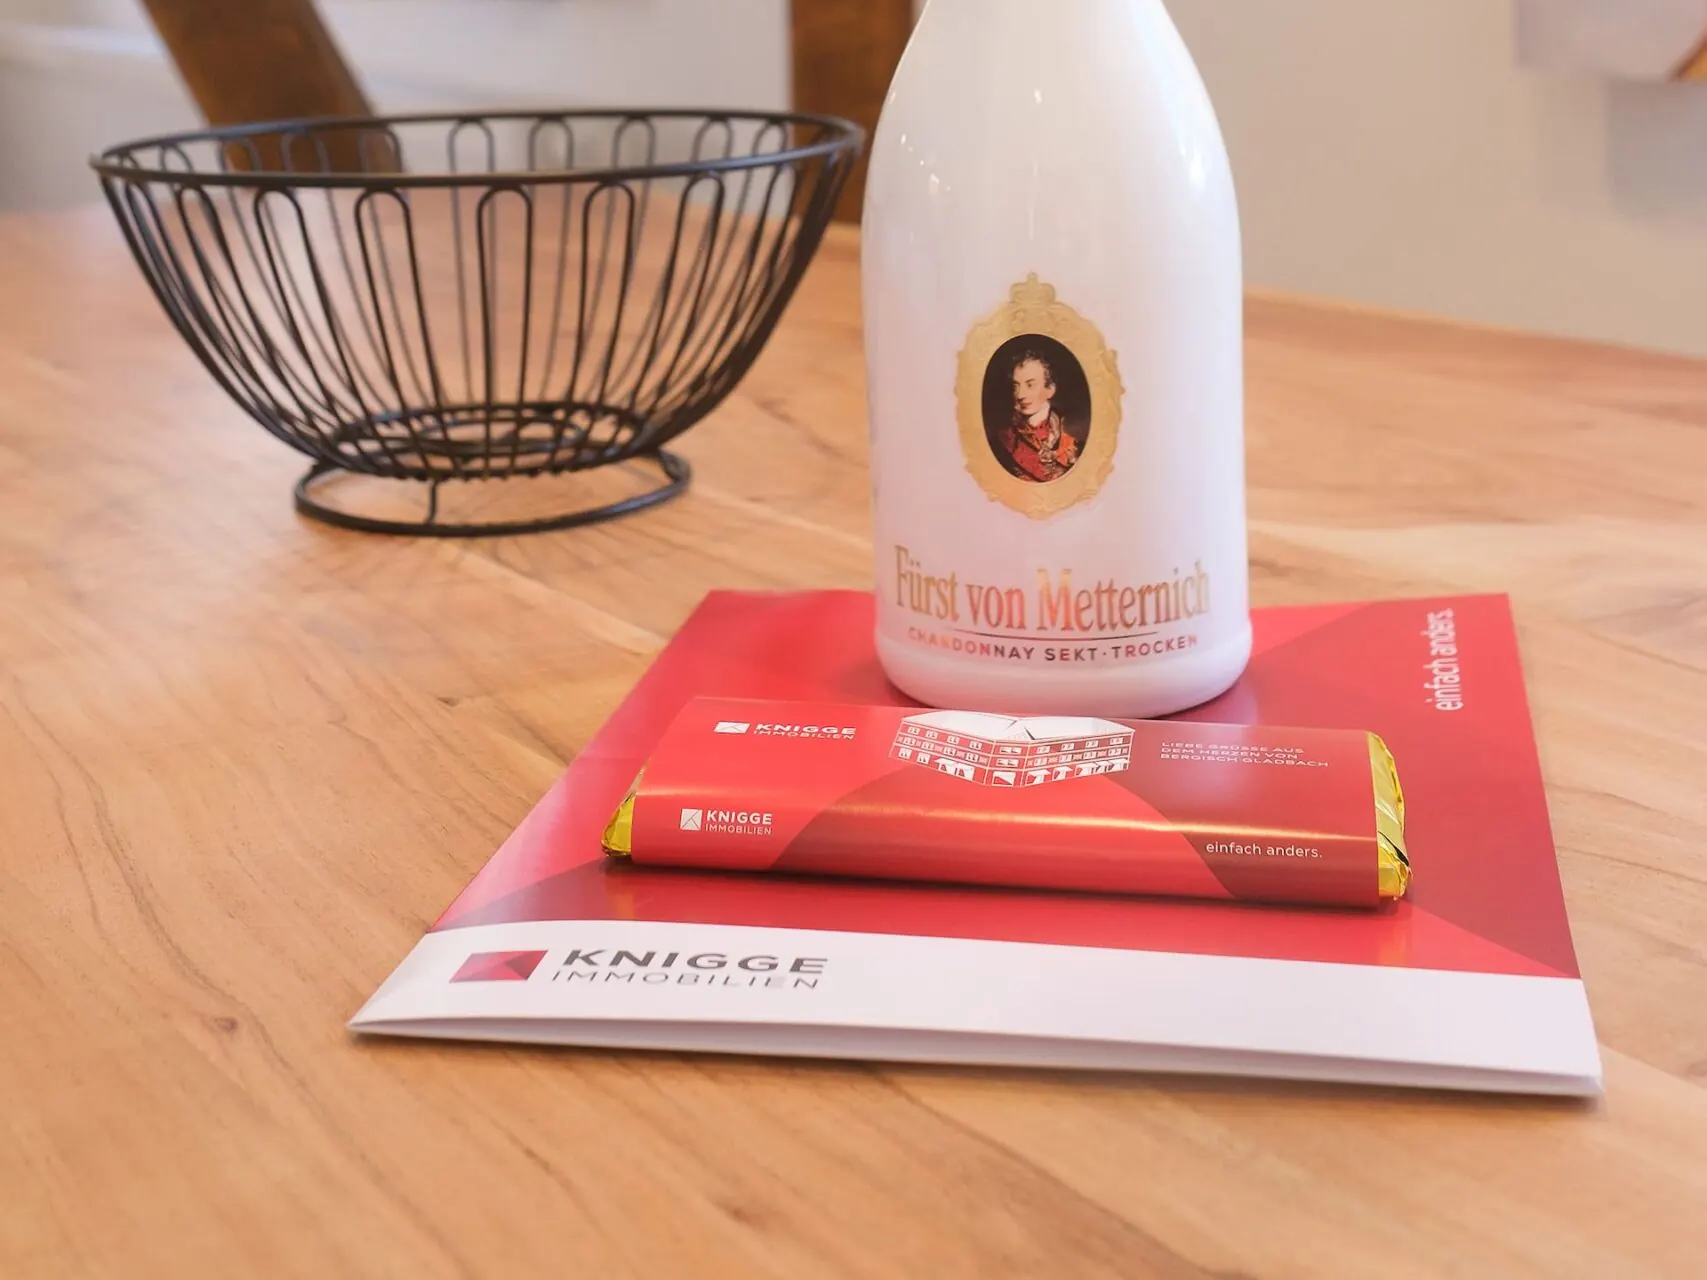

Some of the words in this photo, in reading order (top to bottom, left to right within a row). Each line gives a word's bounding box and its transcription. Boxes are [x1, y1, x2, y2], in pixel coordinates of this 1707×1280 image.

[894, 545, 959, 622] Fürst
[965, 581, 1027, 631] von
[1036, 558, 1209, 633] Metternich
[907, 626, 1036, 661] CHARDONNAY
[1423, 658, 1464, 711] einfach
[753, 730, 855, 741] IMMOBILIEN
[755, 723, 857, 736] KNIGGE
[1199, 750, 1260, 758] HERZEN
[1208, 743, 1269, 752] GRÜSSE
[1160, 754, 1238, 762] BERGISCH
[1242, 758, 1329, 767] GLADBACH
[706, 809, 773, 825] KNIGGE
[705, 823, 773, 836] IMMOBILIEN
[1206, 841, 1261, 855] einfach
[1266, 844, 1322, 858] anders.
[562, 949, 829, 974] KNIGGE
[551, 971, 819, 989] IMMOBILIEN
